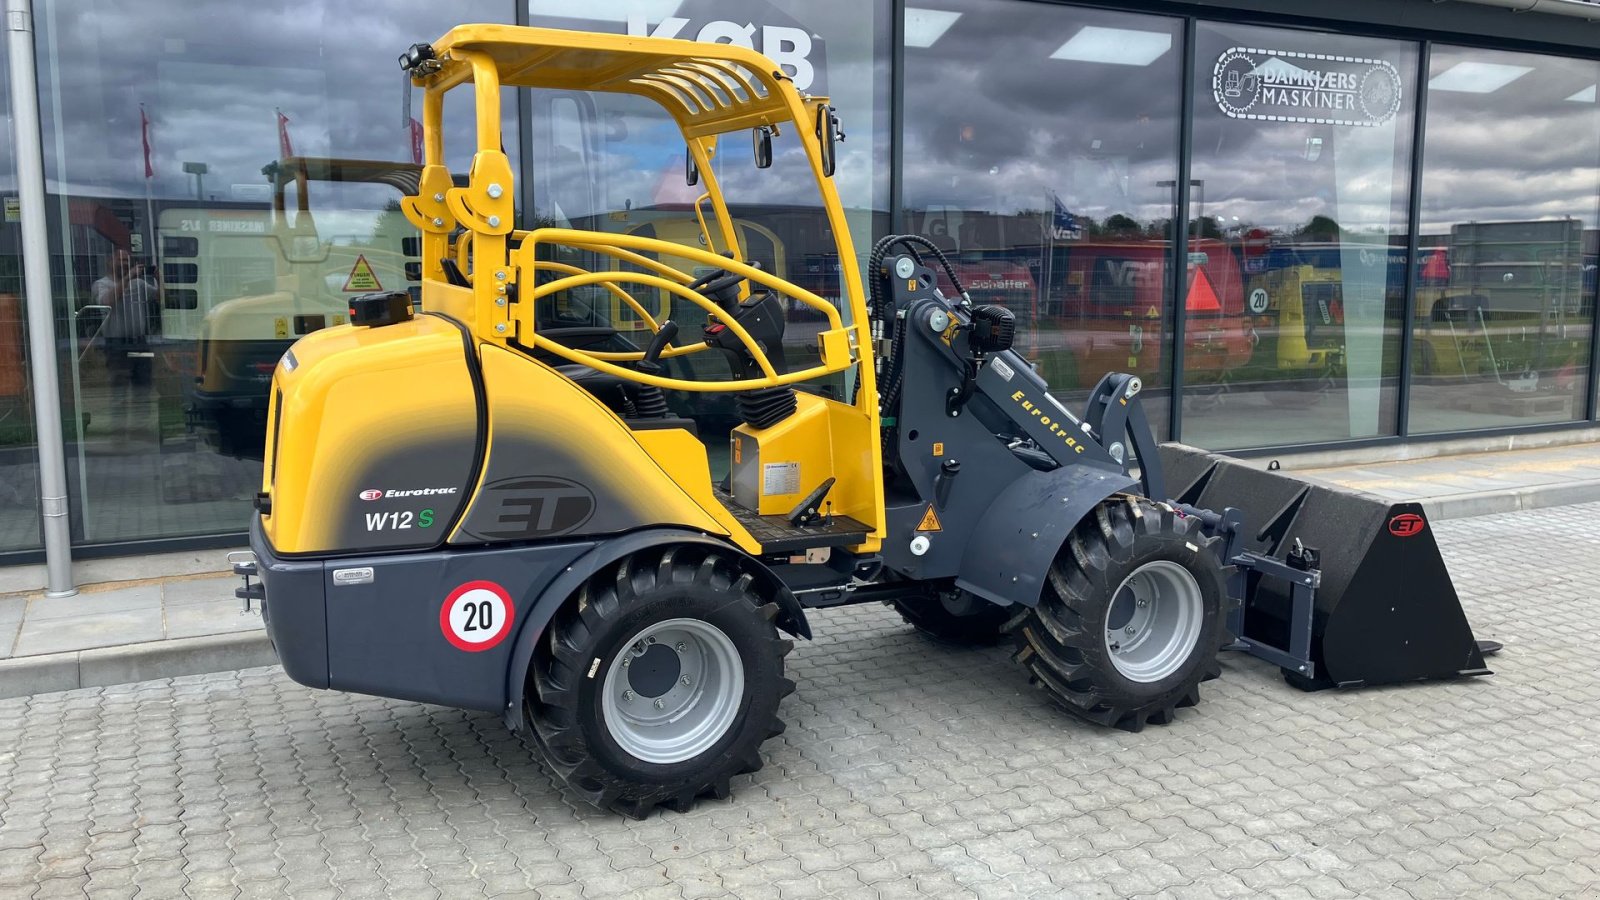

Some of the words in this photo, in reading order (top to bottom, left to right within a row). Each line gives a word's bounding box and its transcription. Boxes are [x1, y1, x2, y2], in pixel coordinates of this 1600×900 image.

[1263, 67, 1357, 91] DAMKJÆRS
[1262, 88, 1356, 110] MASKINER
[1254, 292, 1265, 308] 20
[1011, 390, 1085, 454] Eurotrac
[361, 490, 380, 500] ET
[385, 487, 458, 498] Eurotrac
[365, 511, 414, 531] W12
[418, 509, 434, 529] S
[478, 485, 592, 535] ET
[1390, 516, 1423, 534] ET
[463, 600, 493, 632] 20
